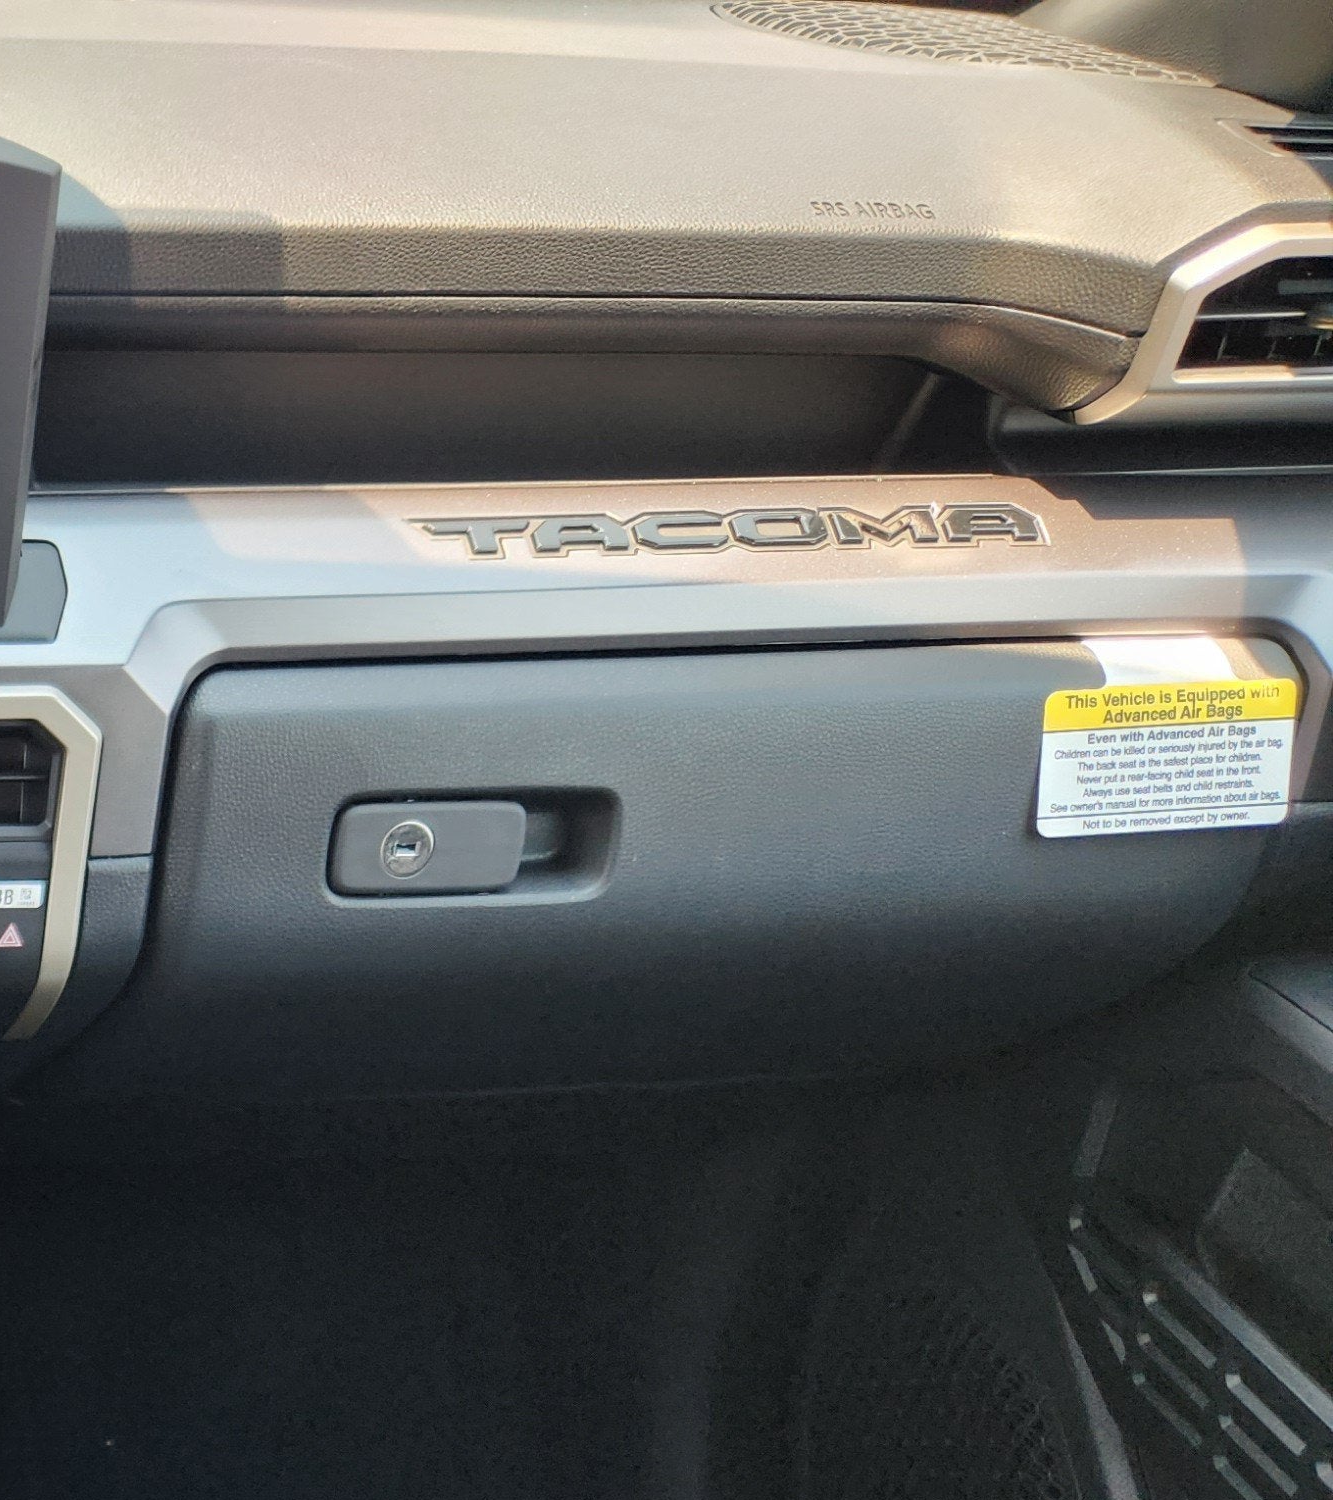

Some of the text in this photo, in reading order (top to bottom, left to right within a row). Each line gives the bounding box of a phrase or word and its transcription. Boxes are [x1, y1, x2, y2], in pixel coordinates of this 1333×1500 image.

[810, 201, 936, 219] SRS AIRBAG
[405, 503, 1045, 558] TACOMA
[1066, 684, 1279, 709] This Vehicle is Equipped with
[1103, 705, 1243, 724] Advanced Air Bags
[1088, 726, 1256, 744] Even with Advanced Air Bags
[1055, 750, 1090, 759] Children
[1093, 749, 1108, 757] can
[1111, 747, 1121, 756] be
[1124, 746, 1145, 755] killed
[1158, 743, 1195, 754] seriously
[1198, 742, 1225, 753] injured
[1228, 741, 1238, 751] by
[1241, 740, 1253, 748] the
[1255, 739, 1265, 747] air
[1268, 739, 1283, 749] bag.
[1078, 753, 1262, 771] The back seat is the safest place for children.
[1077, 775, 1102, 785] Never
[1104, 775, 1118, 785] put
[1128, 772, 1172, 782] rear-facing
[1174, 769, 1194, 779] child
[1196, 768, 1214, 778] seat
[1216, 768, 1223, 776] in
[1226, 766, 1239, 775] the
[1242, 765, 1260, 774] front.
[1083, 788, 1113, 798] Always
[1133, 785, 1151, 794] seat
[1153, 784, 1172, 793] belts
[1175, 783, 1191, 792] and
[1193, 782, 1212, 790] child
[1215, 779, 1254, 789] restraints.
[1050, 790, 1280, 813] See owner's manual for more information about air bags.
[1083, 811, 1250, 829] Not to be removed except by owner.
